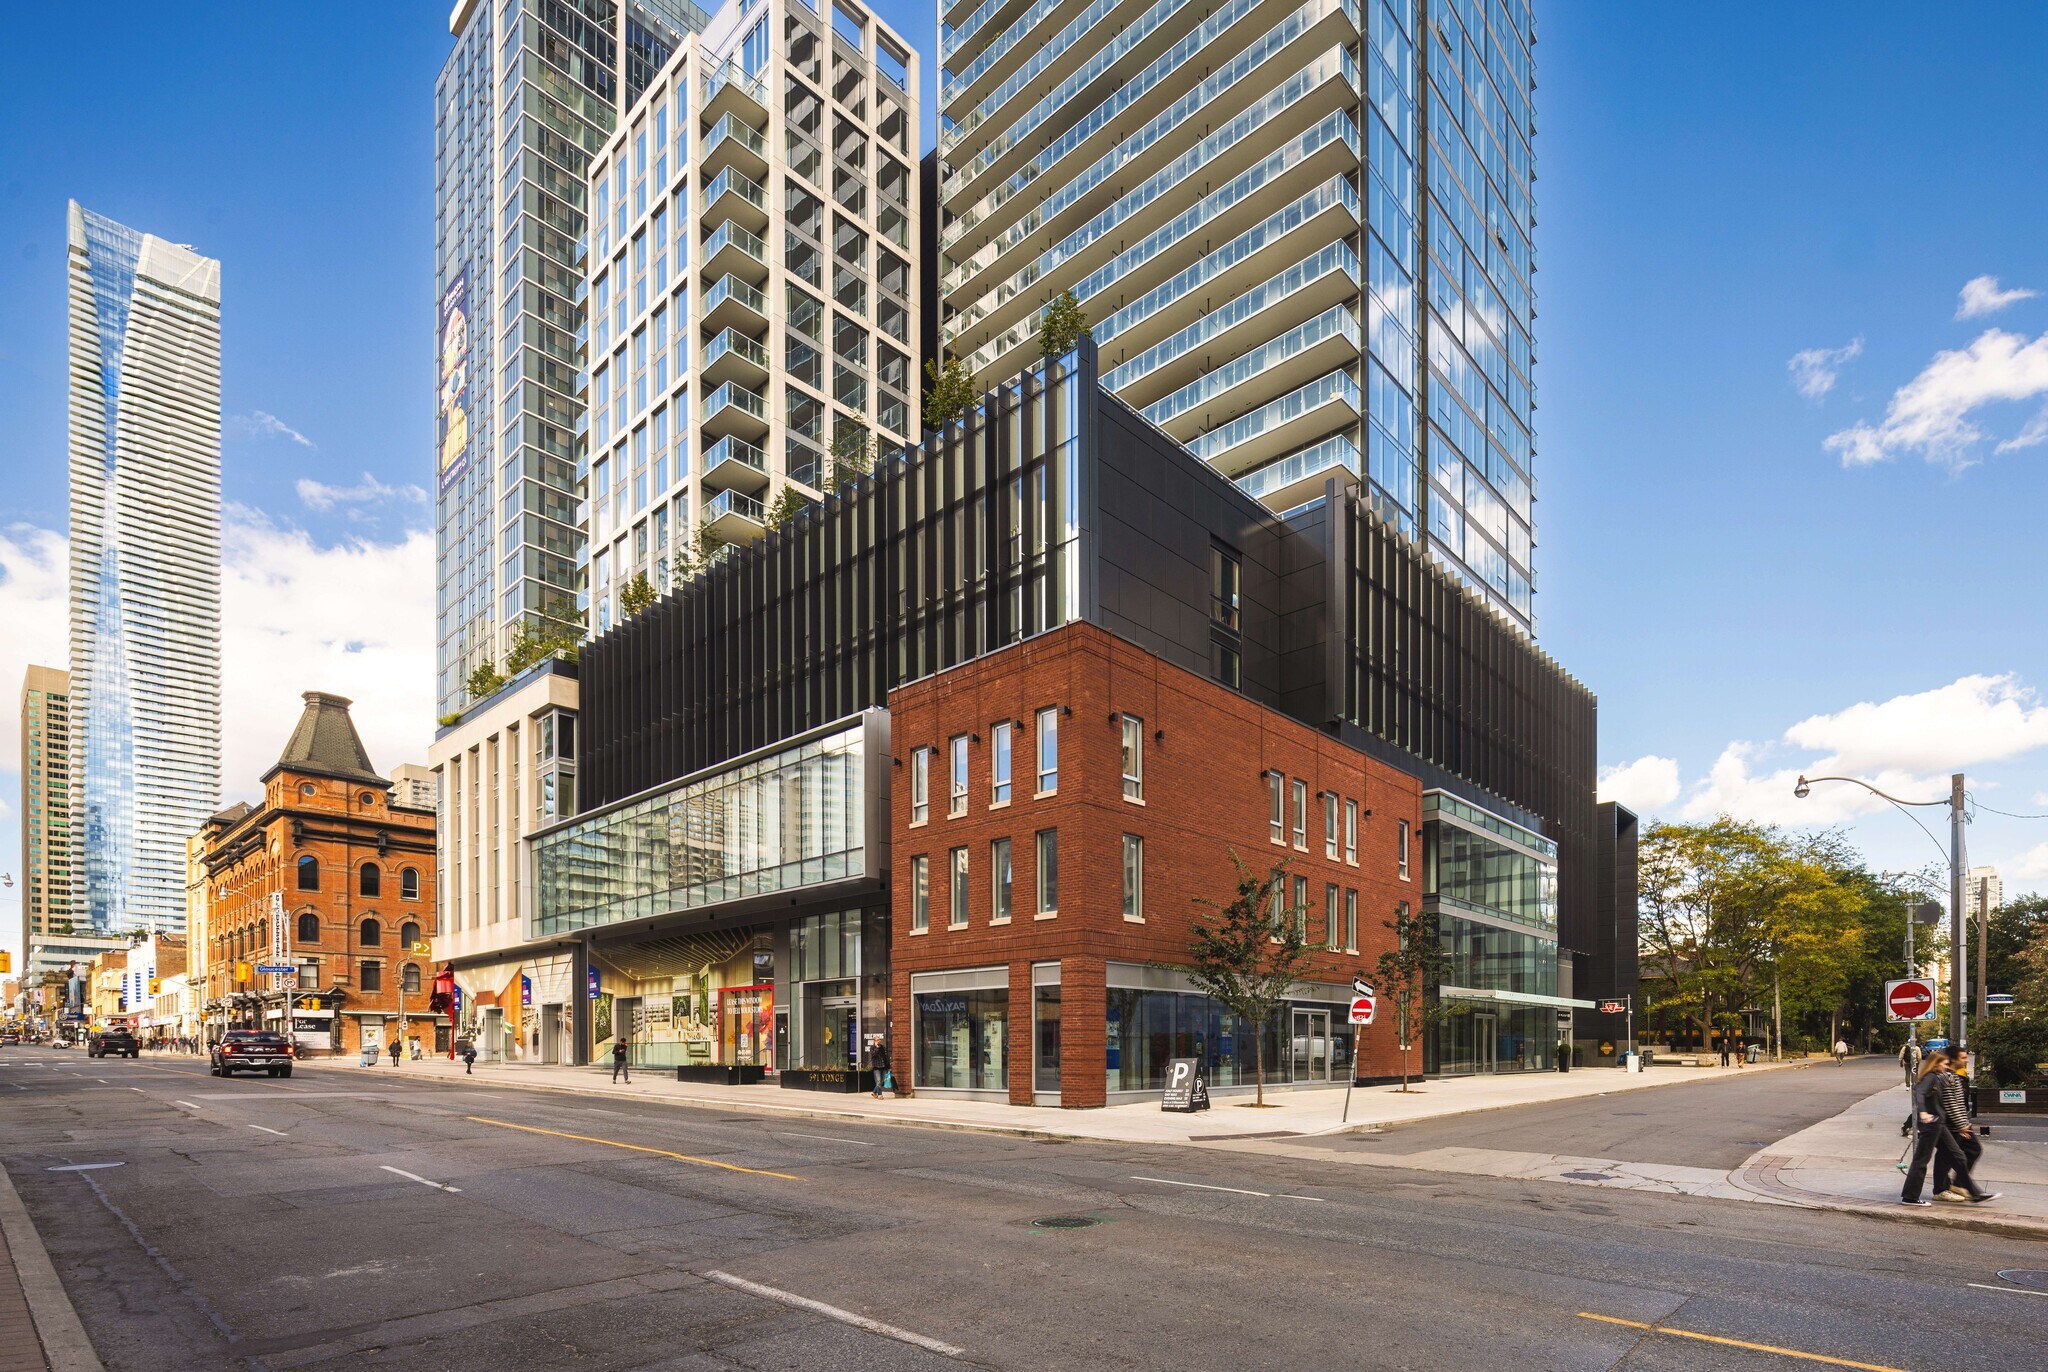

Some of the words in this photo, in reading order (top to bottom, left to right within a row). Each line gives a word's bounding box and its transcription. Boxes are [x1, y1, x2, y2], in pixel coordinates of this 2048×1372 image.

[413, 942, 422, 952] P
[809, 1073, 819, 1082] 591
[821, 1073, 845, 1083] YONGE
[1171, 1062, 1189, 1088] P
[1196, 1080, 1202, 1092] P
